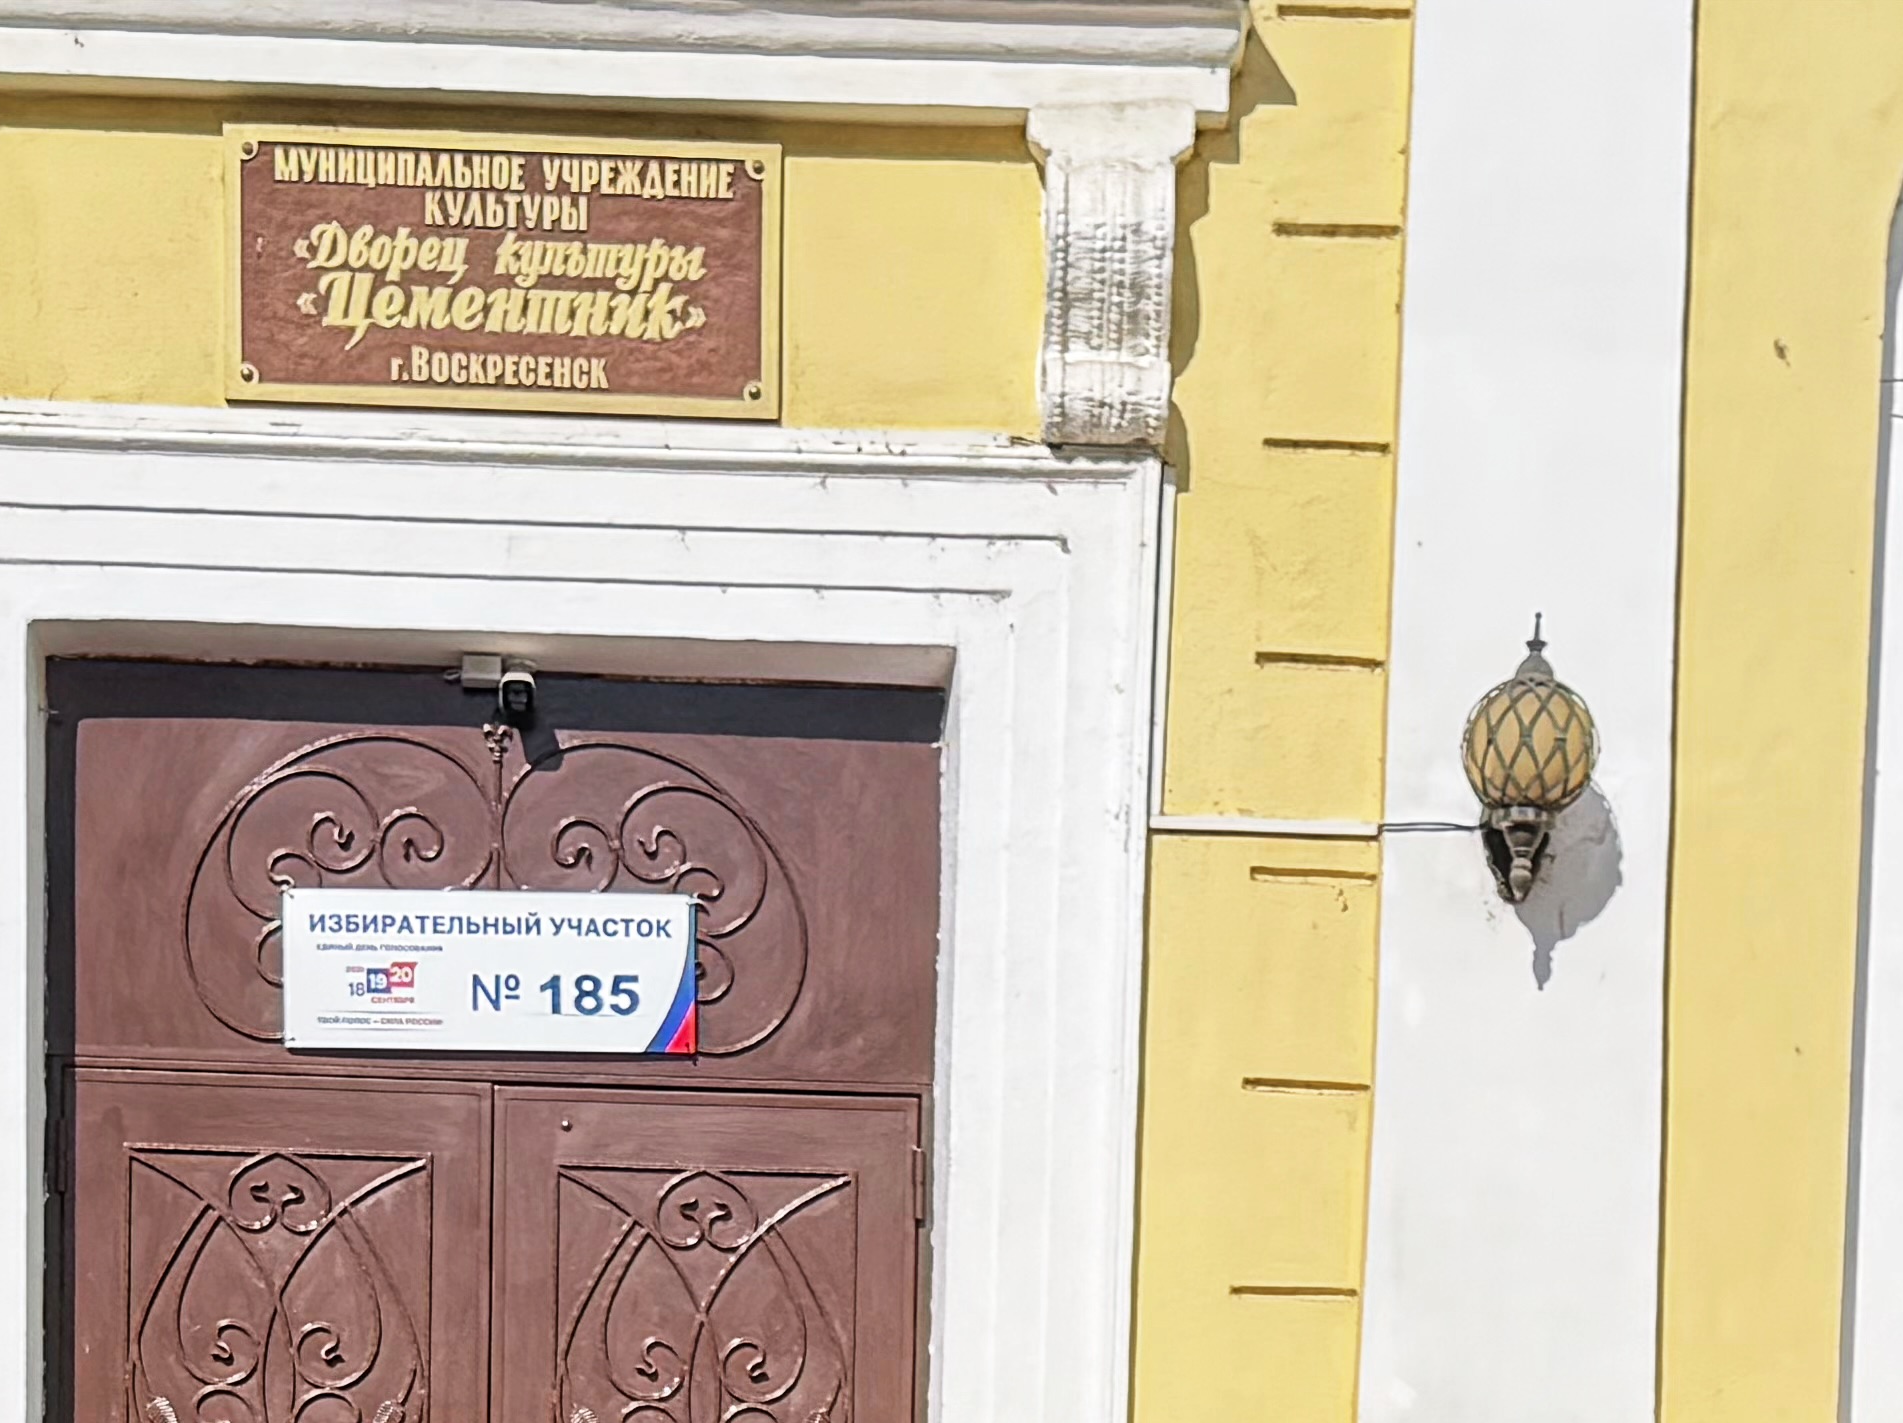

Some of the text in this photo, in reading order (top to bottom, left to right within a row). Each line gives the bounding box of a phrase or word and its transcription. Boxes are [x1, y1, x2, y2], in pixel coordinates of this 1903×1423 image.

[273, 145, 736, 200] МУНИЦИПАЛЬНОЕ УЧРЕЖДЕНИЕ
[424, 190, 588, 232] КУЛЬТУРЫ
[493, 231, 708, 293] культуры
[297, 270, 708, 351] «Цементник»
[307, 911, 674, 940] ИЗБИРАТЕЛЬНЫЙ УЧАСТОК
[347, 965, 414, 997] 18 19 20
[470, 973, 642, 1016] № 185
